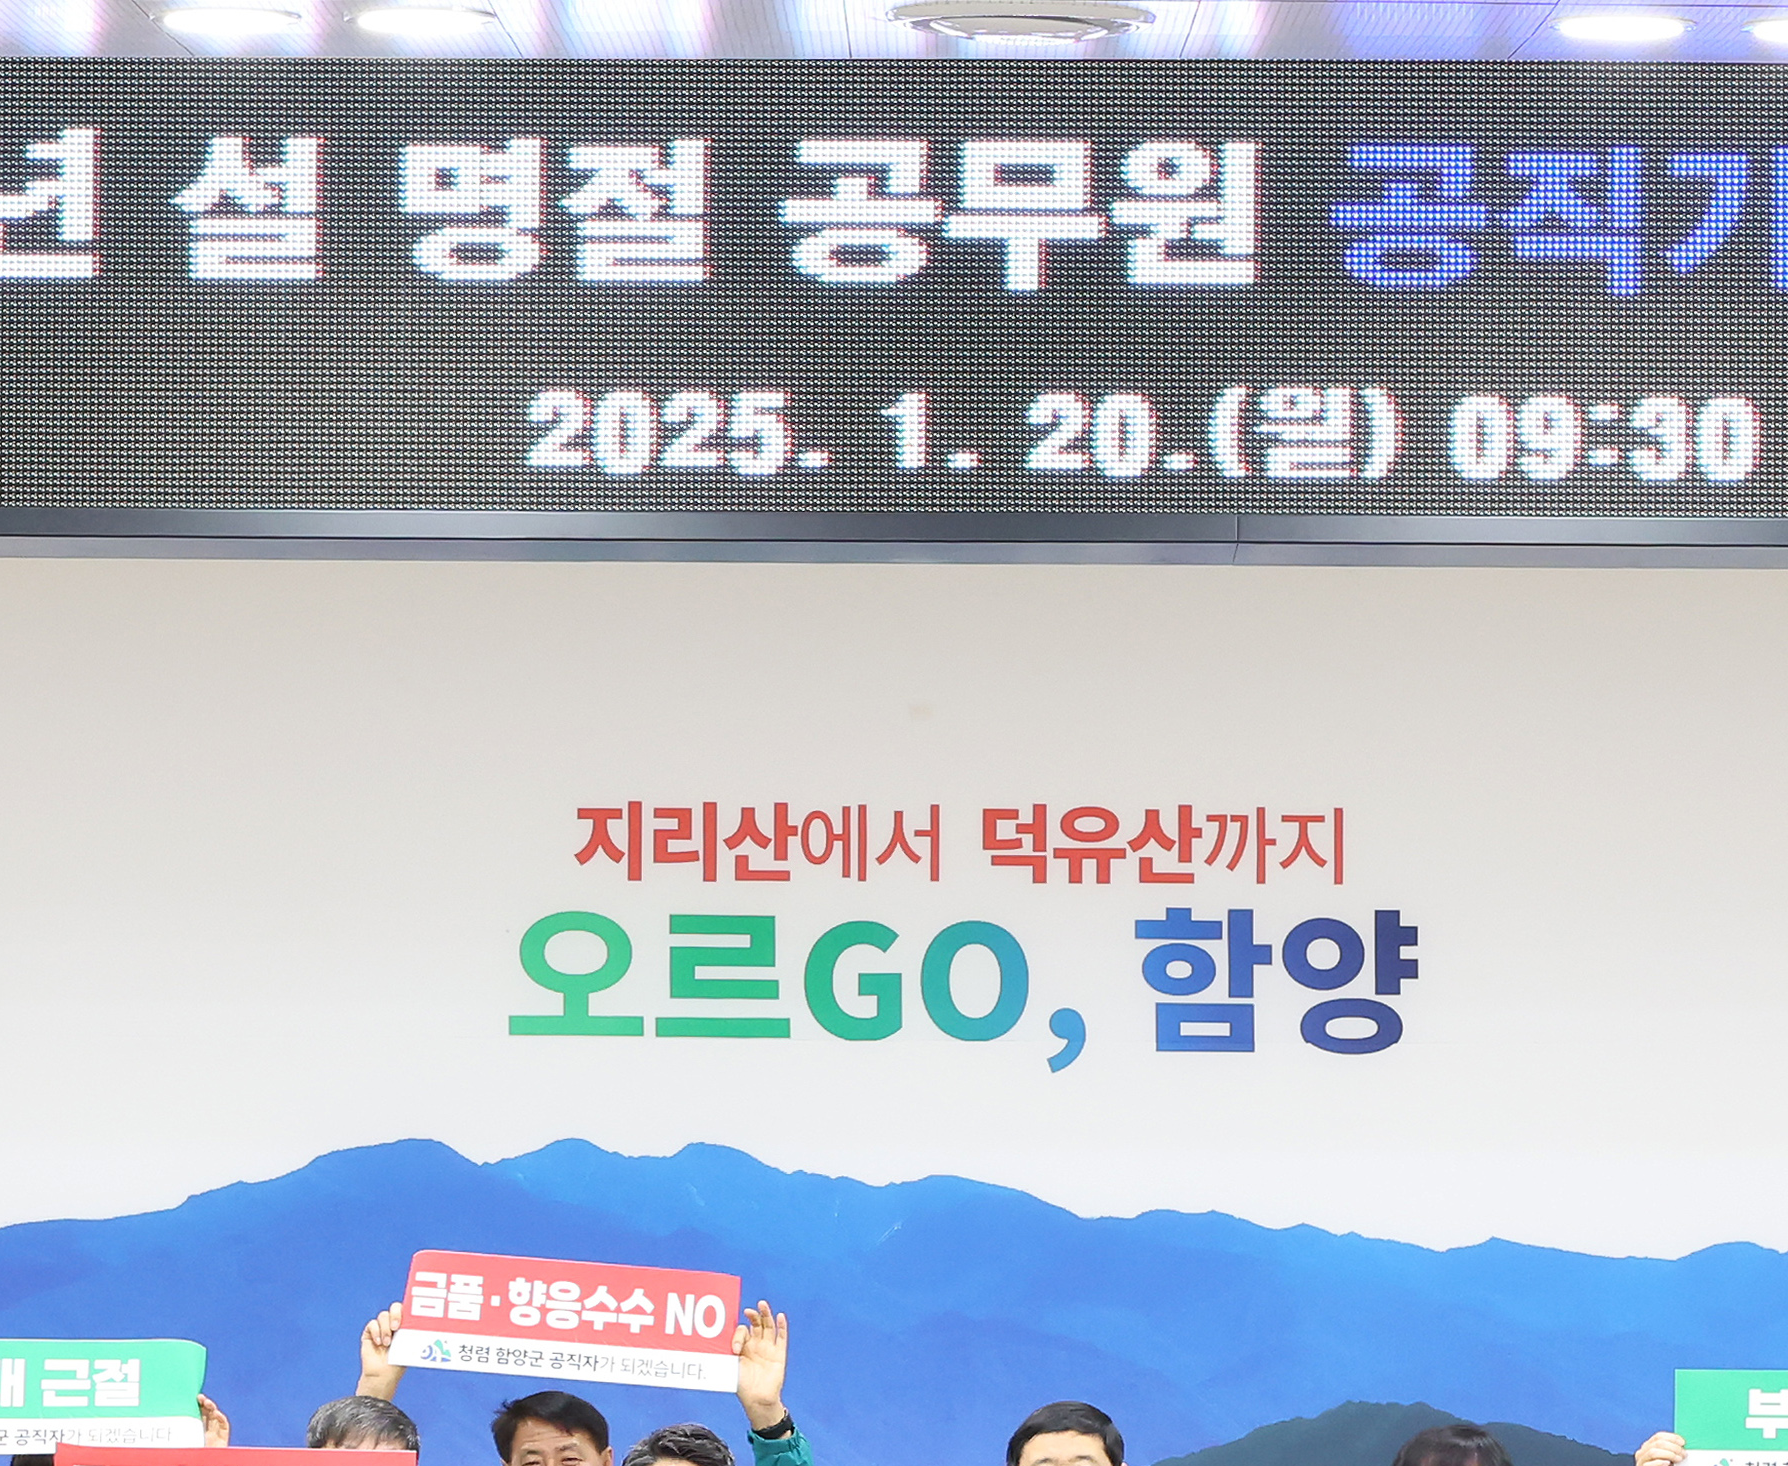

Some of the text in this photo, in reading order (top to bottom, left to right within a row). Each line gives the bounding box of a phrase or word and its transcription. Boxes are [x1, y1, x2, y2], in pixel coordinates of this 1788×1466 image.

[171, 135, 324, 282] 설
[396, 135, 708, 283] 명절
[779, 135, 1262, 293] 공무원
[524, 388, 830, 475] 2025.
[879, 392, 979, 471] 1.
[1452, 392, 1759, 485] 09:30
[574, 801, 1344, 886] 지리산에서 덕유산까지
[508, 907, 1419, 1074] 오르GO, 함양
[457, 1343, 491, 1364] 청렴
[494, 1346, 545, 1368] 함양군
[548, 1351, 615, 1374] 공직자가
[664, 1292, 728, 1340] NO
[40, 1358, 142, 1407] 근절
